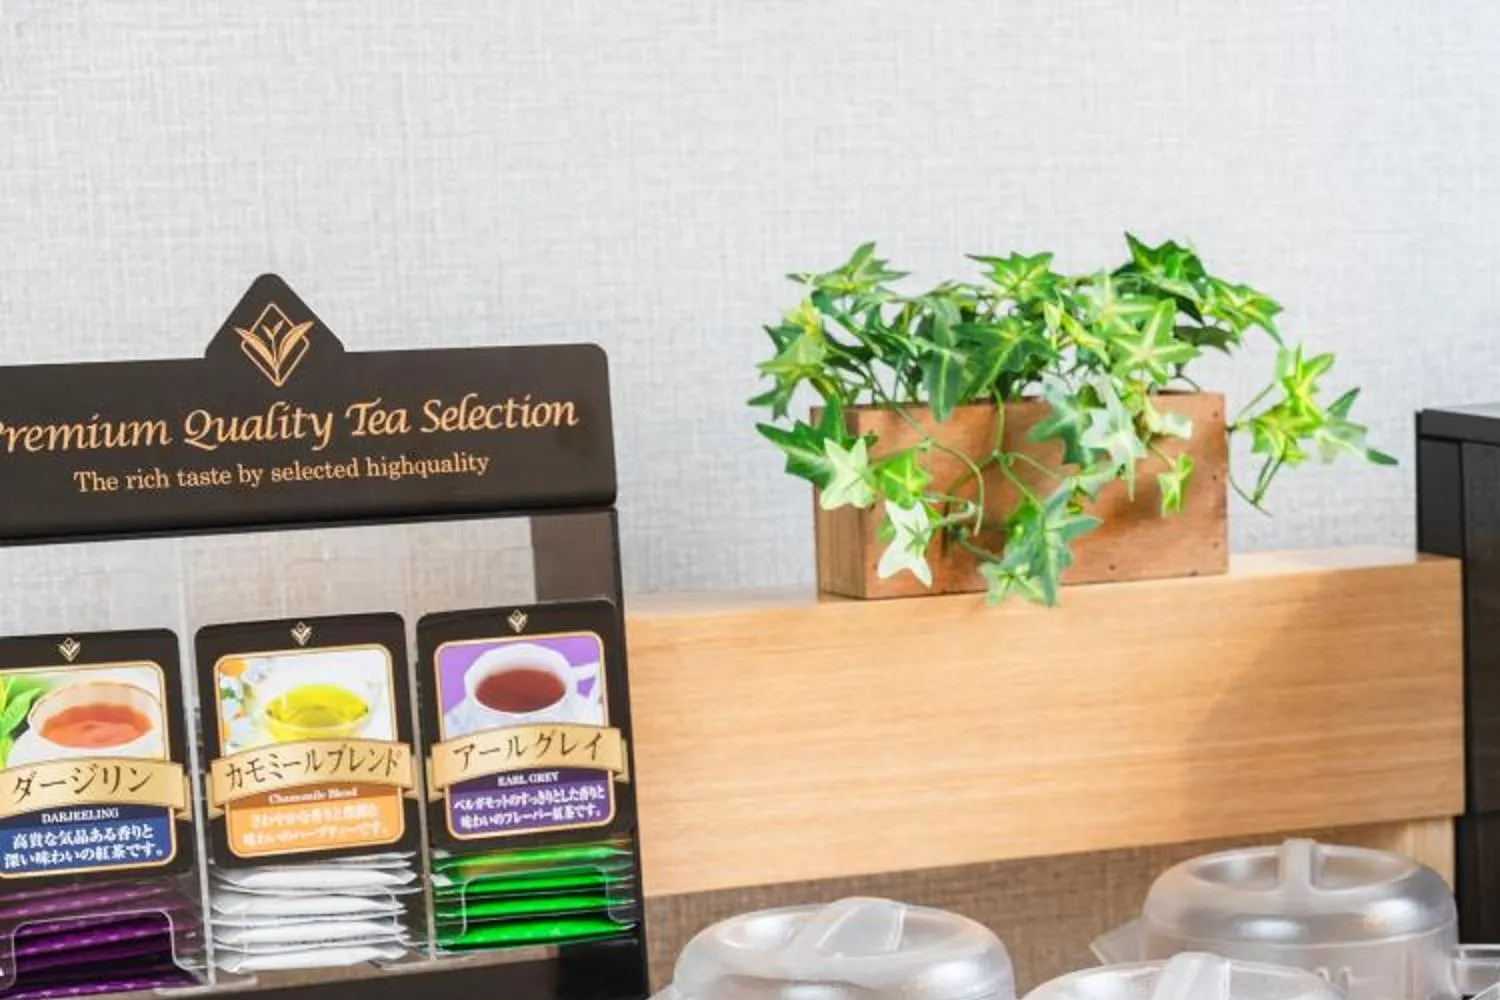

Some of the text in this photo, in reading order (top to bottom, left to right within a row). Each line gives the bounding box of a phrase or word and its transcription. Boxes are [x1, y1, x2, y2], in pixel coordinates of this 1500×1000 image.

[0, 393, 580, 452] remium Quality Tea Selection
[73, 451, 491, 492] The rich taste by selected highquality
[226, 743, 402, 791] カモミールブレンド
[452, 729, 604, 771] アールグレイ
[13, 763, 153, 804] ダージリン
[328, 786, 358, 800] Blend
[497, 771, 560, 787] EARL GREY
[41, 807, 120, 825] DARJEELING
[12, 823, 155, 851] 高貴な気品ある香りと
[3, 842, 164, 870] 深い味わいの紅茶です。
